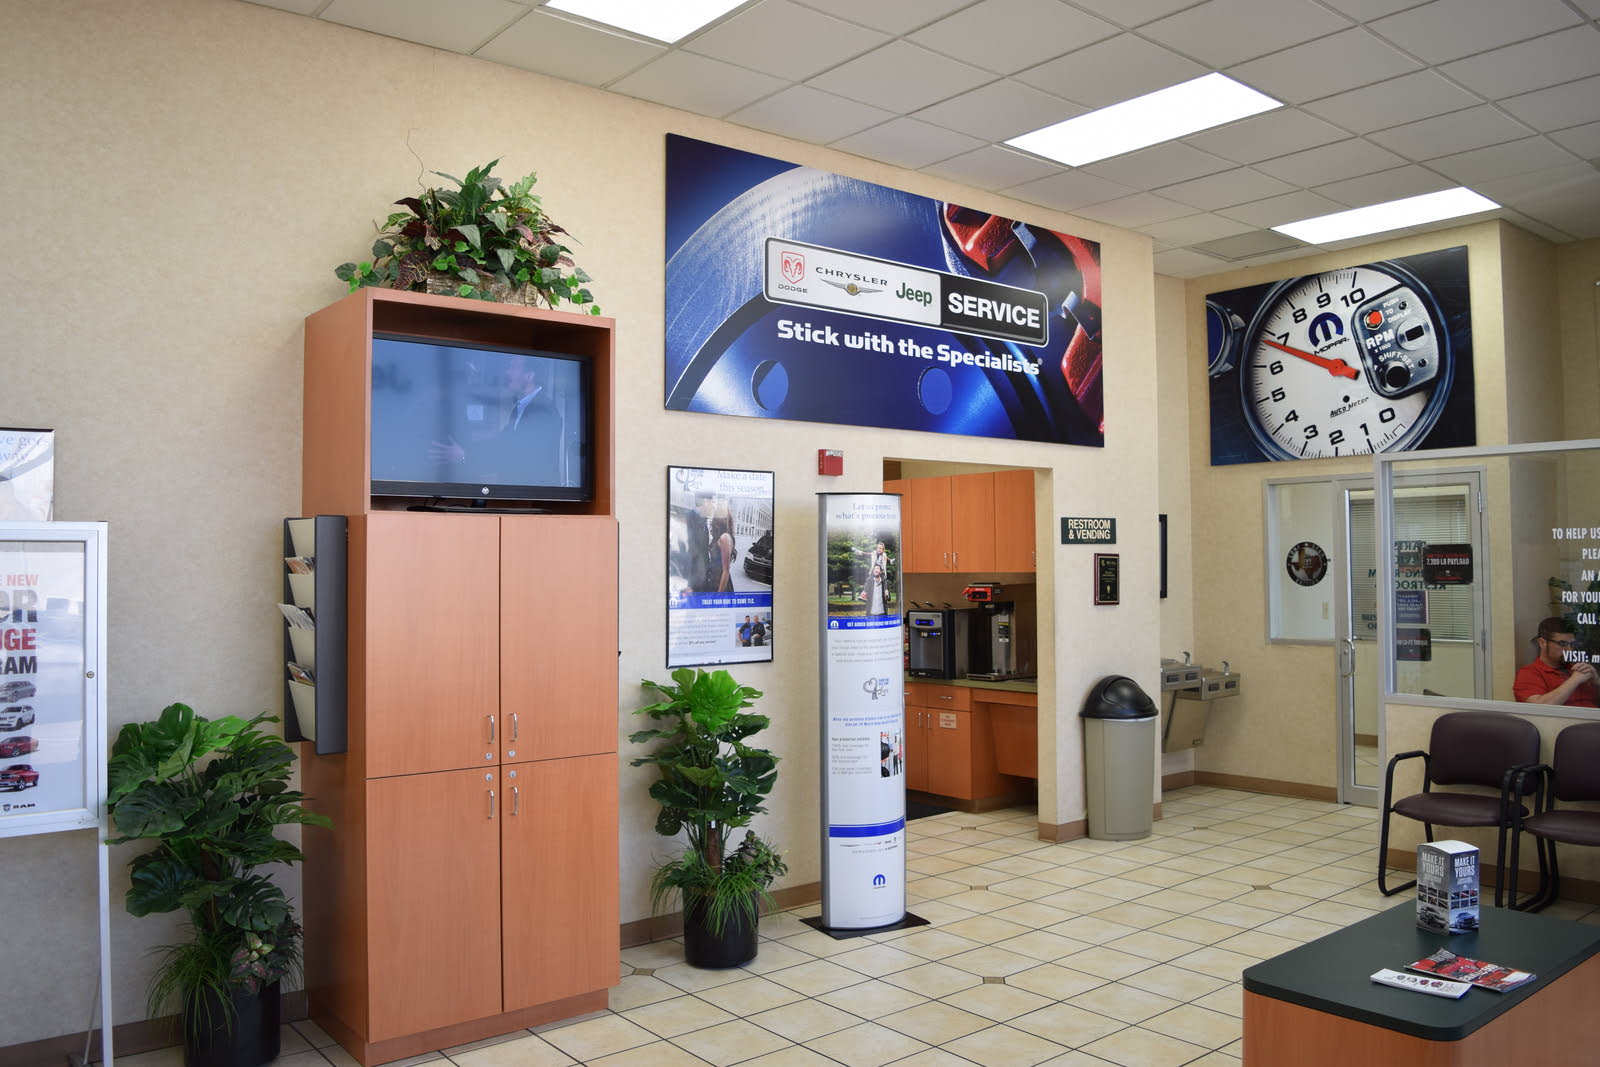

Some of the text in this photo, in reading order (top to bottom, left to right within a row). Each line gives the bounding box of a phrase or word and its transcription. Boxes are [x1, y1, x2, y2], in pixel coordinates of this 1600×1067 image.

[778, 284, 808, 293] DODGE
[815, 266, 1040, 328] CHRYSLER Jeep SERVICE
[1316, 293, 1331, 308] 9
[1340, 288, 1366, 308] 10
[1383, 297, 1399, 308] PUSH
[1293, 308, 1307, 323] 8
[1278, 332, 1290, 346] 7
[1366, 329, 1395, 349] RPM
[777, 319, 1039, 375] Stick with the Specialists
[1313, 337, 1349, 356] MOPAR
[1379, 351, 1415, 368] SHIFT-SET
[1270, 361, 1284, 375] 6
[1271, 387, 1286, 402] 5
[1284, 410, 1299, 423] 4
[1379, 408, 1396, 423] 0
[1304, 424, 1318, 439] 3
[1360, 423, 1369, 436] 1
[1329, 430, 1345, 445] 2
[1068, 519, 1111, 530] RESTROOM
[1068, 529, 1111, 540] & VENDING
[1552, 528, 1563, 539] TO
[1566, 528, 1587, 539] HELP
[6, 574, 39, 587] NEW
[1581, 570, 1595, 581] AN
[1562, 591, 1600, 603] FOR YOU
[1577, 613, 1597, 625] CALL
[0, 628, 37, 651] GE
[1562, 650, 1589, 662] VISIT:
[0, 655, 37, 674] AM
[1422, 852, 1445, 866] MAKE IT
[1454, 855, 1475, 868] MAKE IT
[1422, 861, 1444, 877] YOURS
[1455, 865, 1475, 878] YOURS
